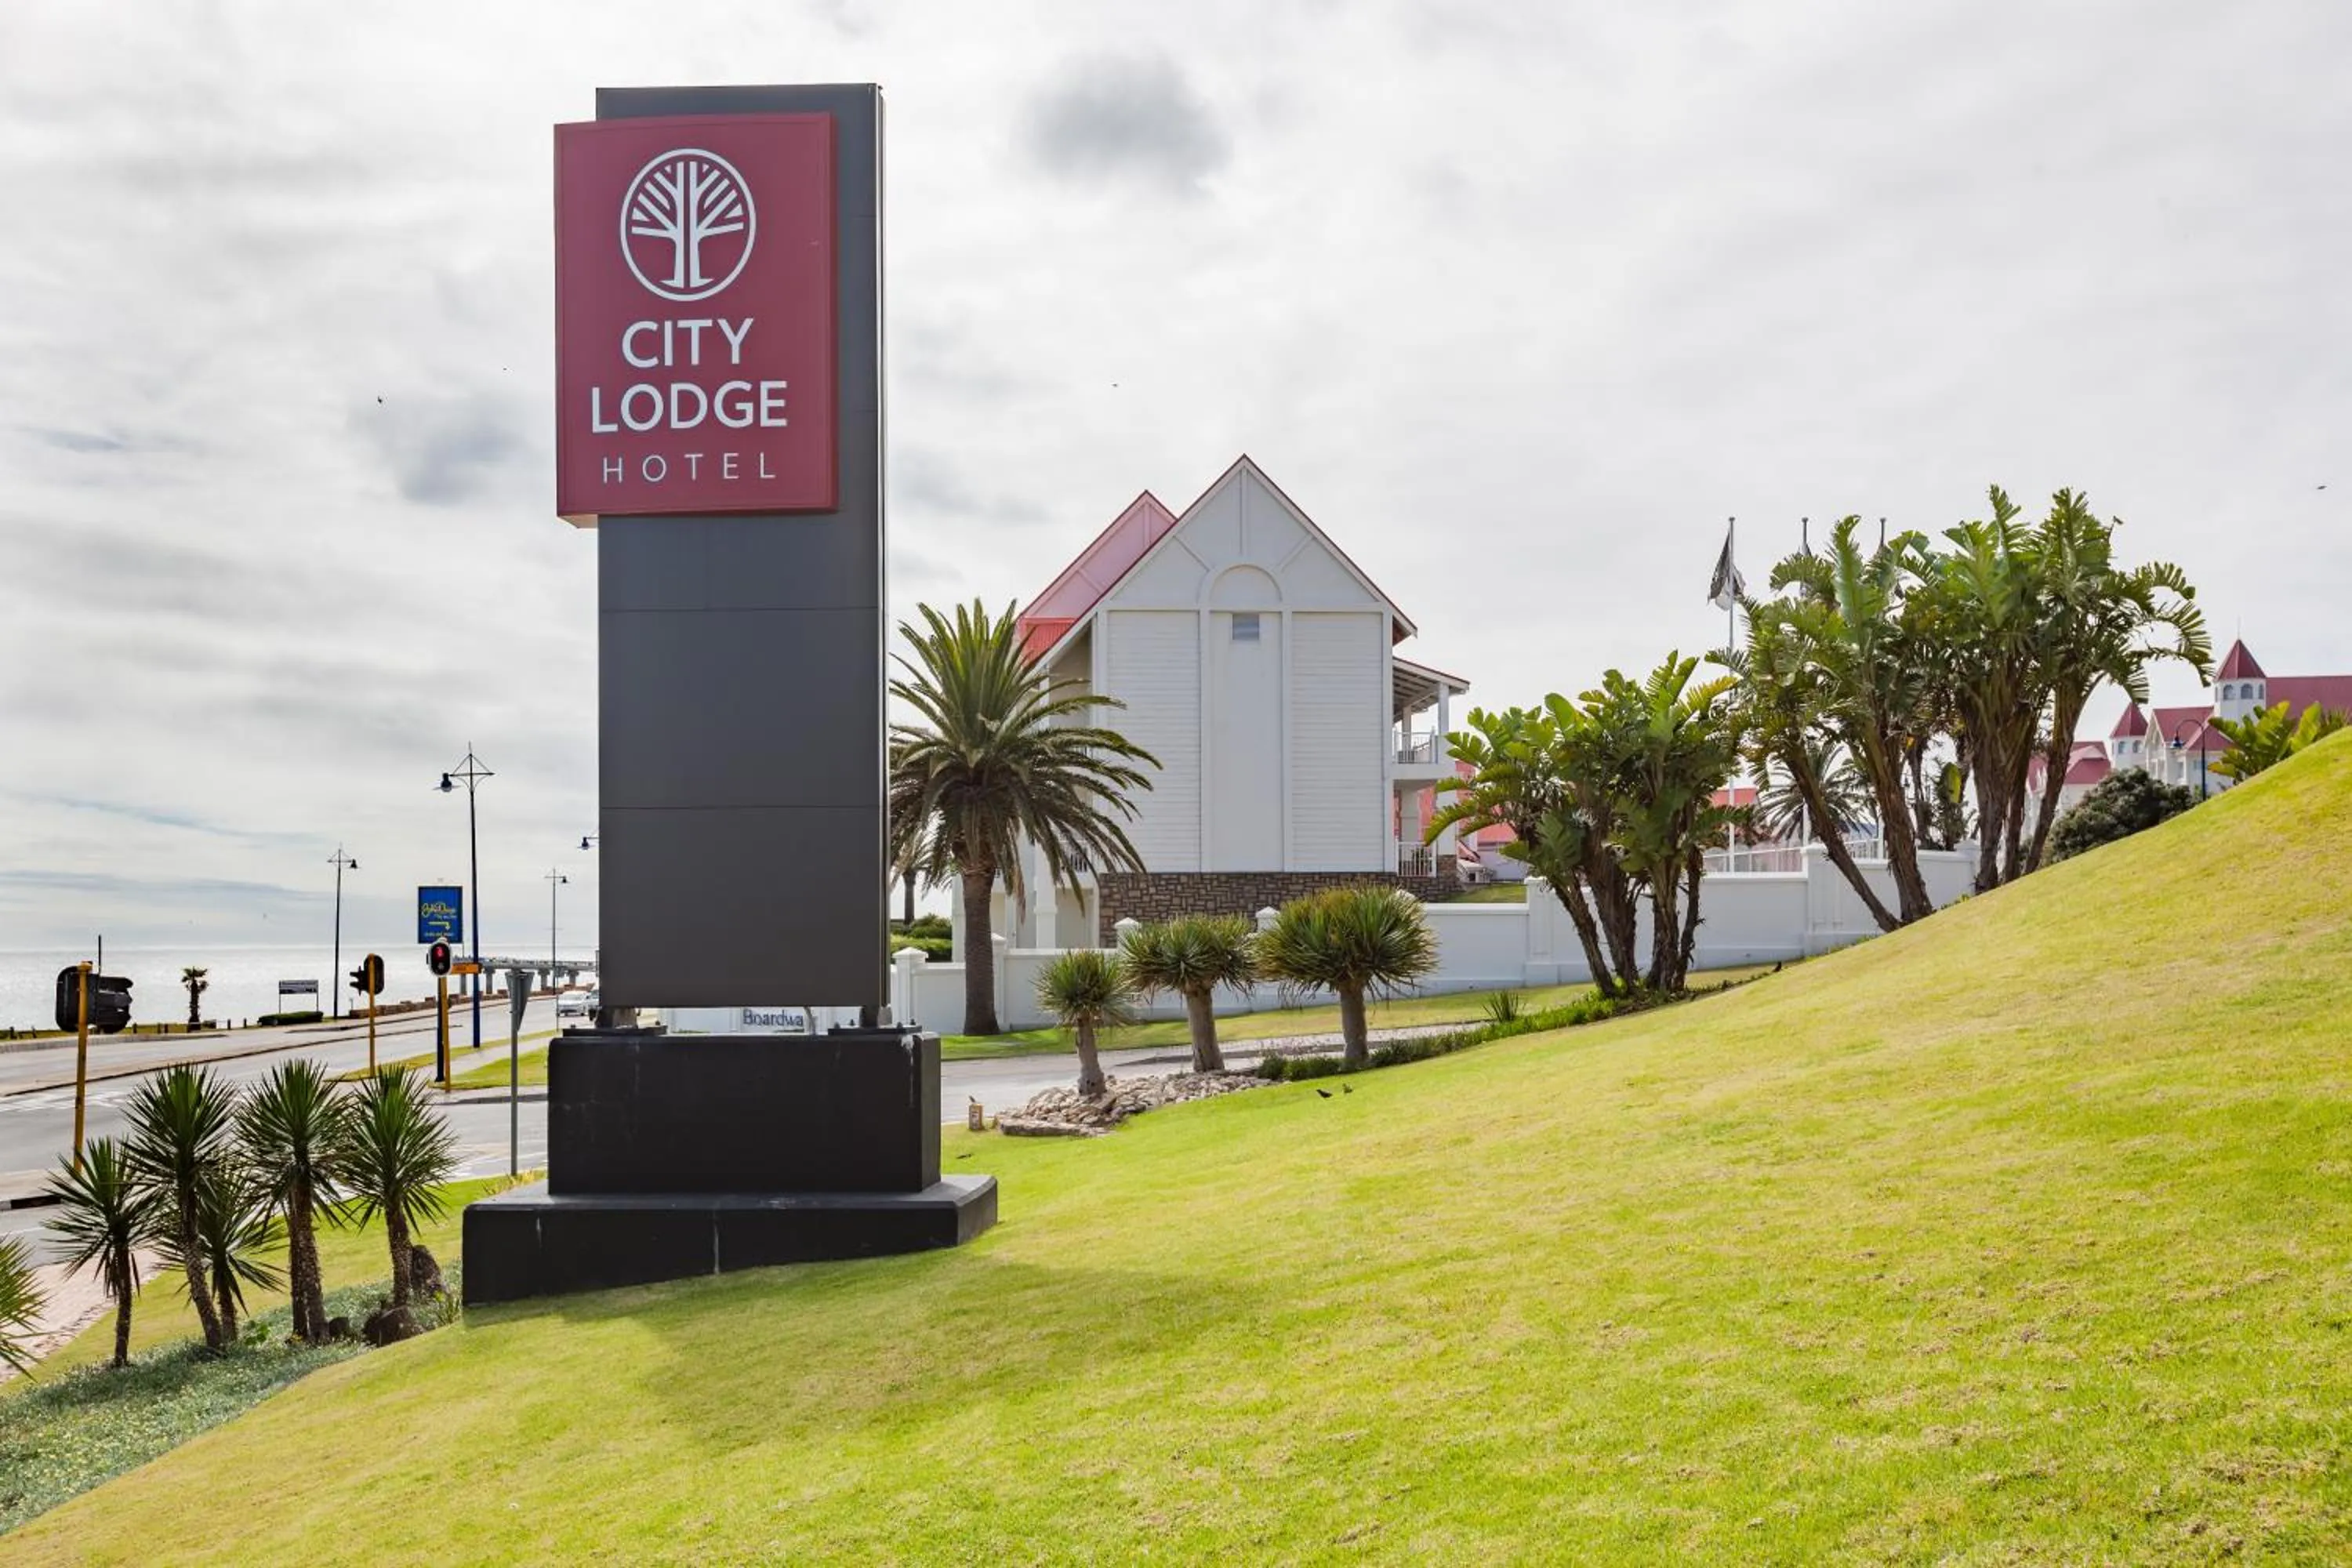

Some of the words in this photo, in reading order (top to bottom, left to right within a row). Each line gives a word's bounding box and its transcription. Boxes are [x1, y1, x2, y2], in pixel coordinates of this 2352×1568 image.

[622, 318, 754, 368] CITY
[592, 380, 788, 433] LODGE
[602, 452, 776, 484] HOTEL
